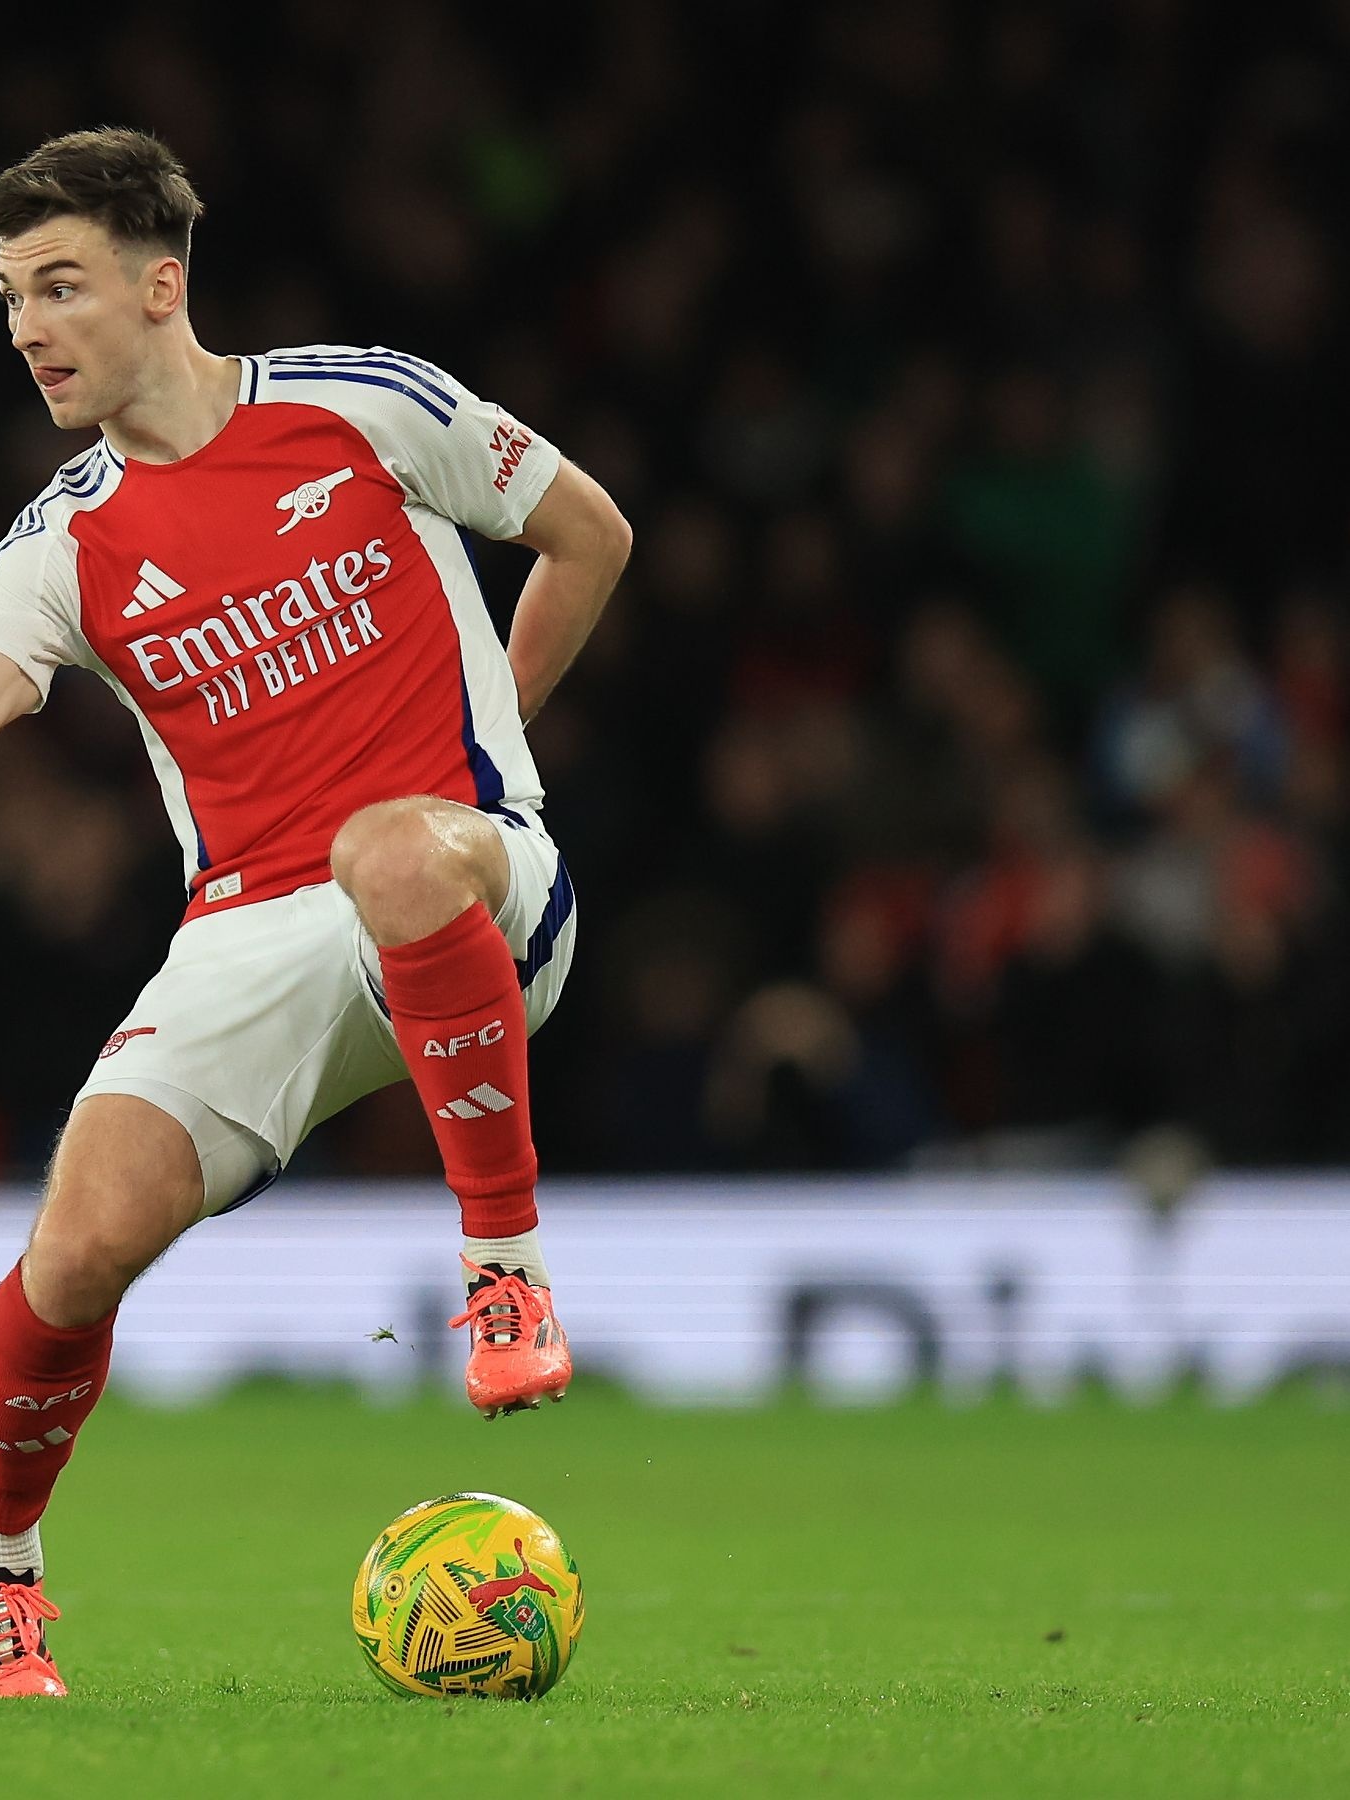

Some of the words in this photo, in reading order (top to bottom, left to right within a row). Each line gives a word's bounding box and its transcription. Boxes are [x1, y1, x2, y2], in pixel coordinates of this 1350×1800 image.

[489, 418, 515, 452] VIS
[492, 427, 532, 494] RWAN
[126, 538, 391, 691] Emirates
[197, 665, 250, 725] FLY
[254, 598, 383, 697] BETTER
[423, 1020, 505, 1058] AFC
[4, 1380, 92, 1410] AFC
